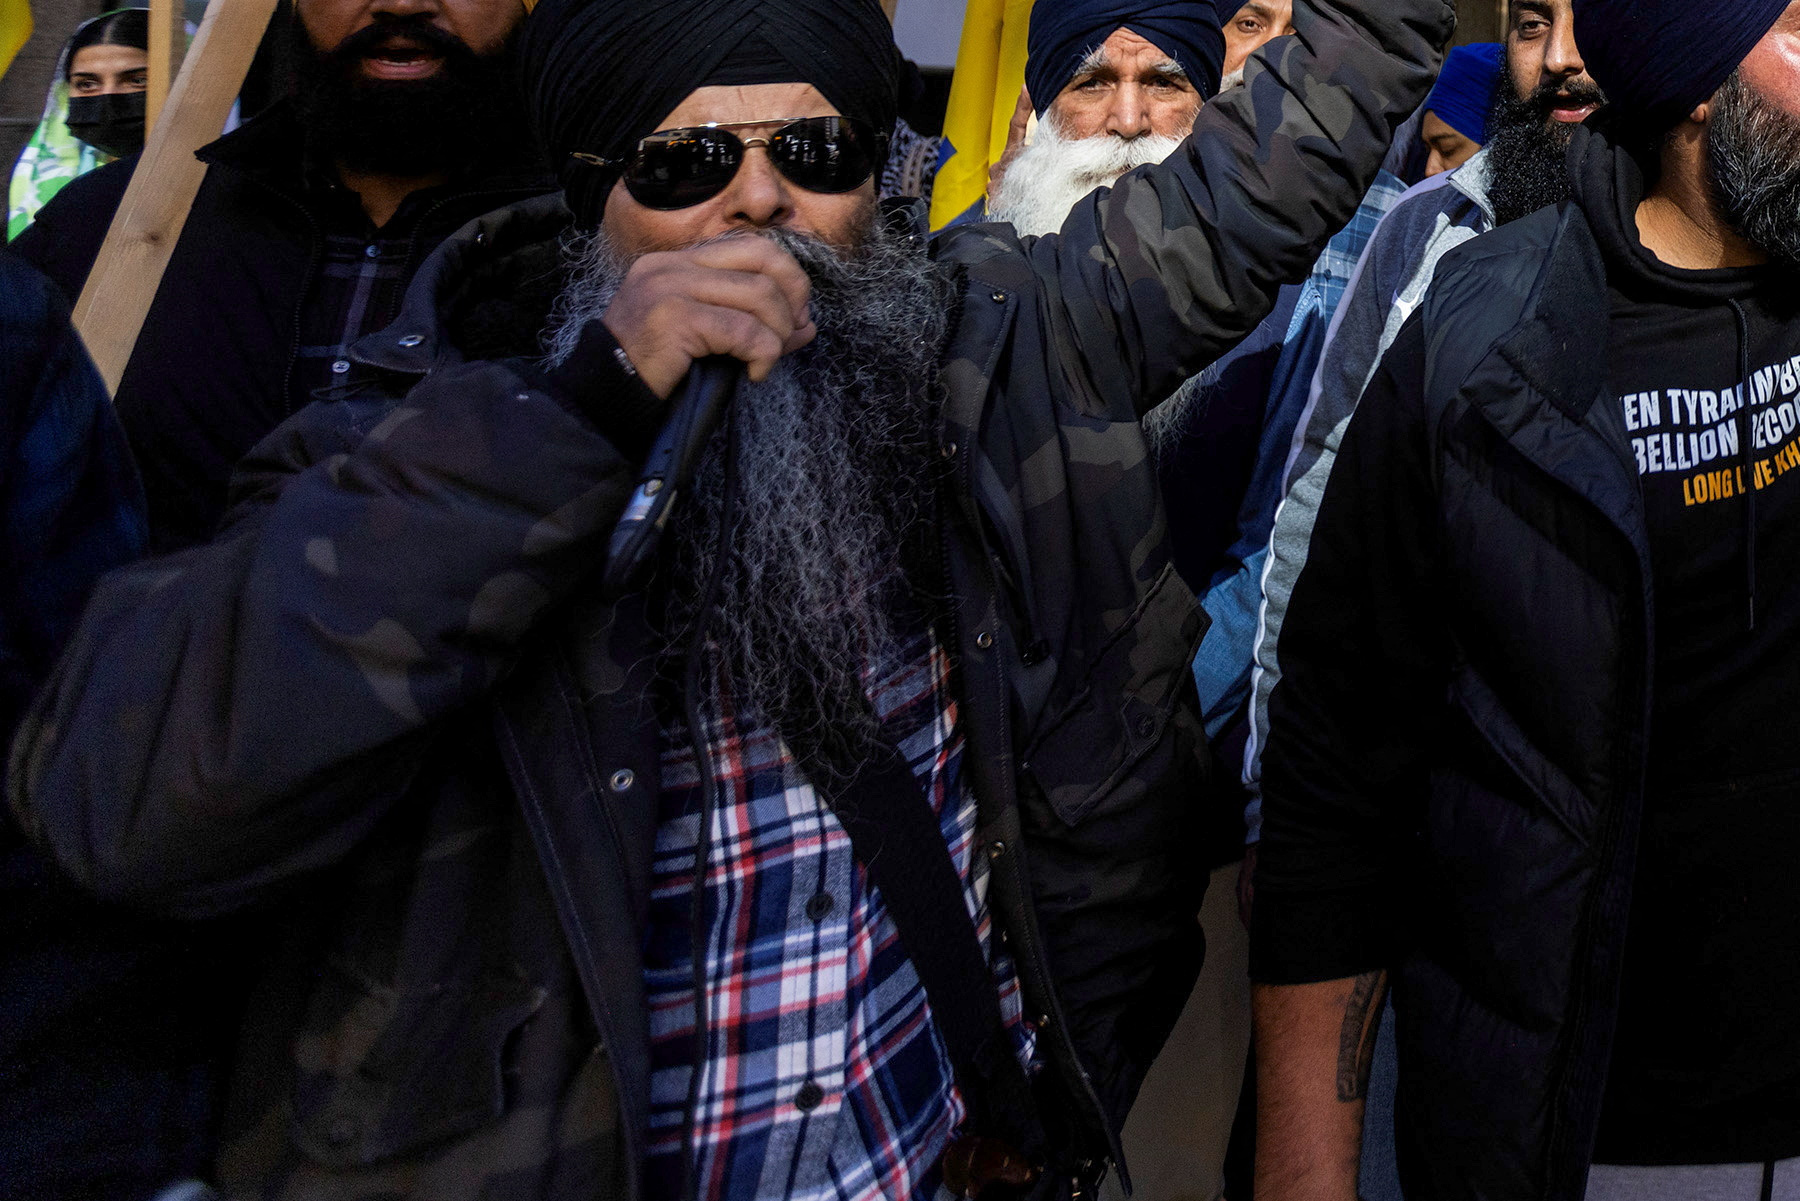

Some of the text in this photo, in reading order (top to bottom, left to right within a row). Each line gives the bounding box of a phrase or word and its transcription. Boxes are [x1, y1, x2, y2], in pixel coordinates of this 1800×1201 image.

[1619, 390, 1661, 431] EN
[1682, 468, 1735, 507] LONG
[1735, 459, 1776, 495] LVE
